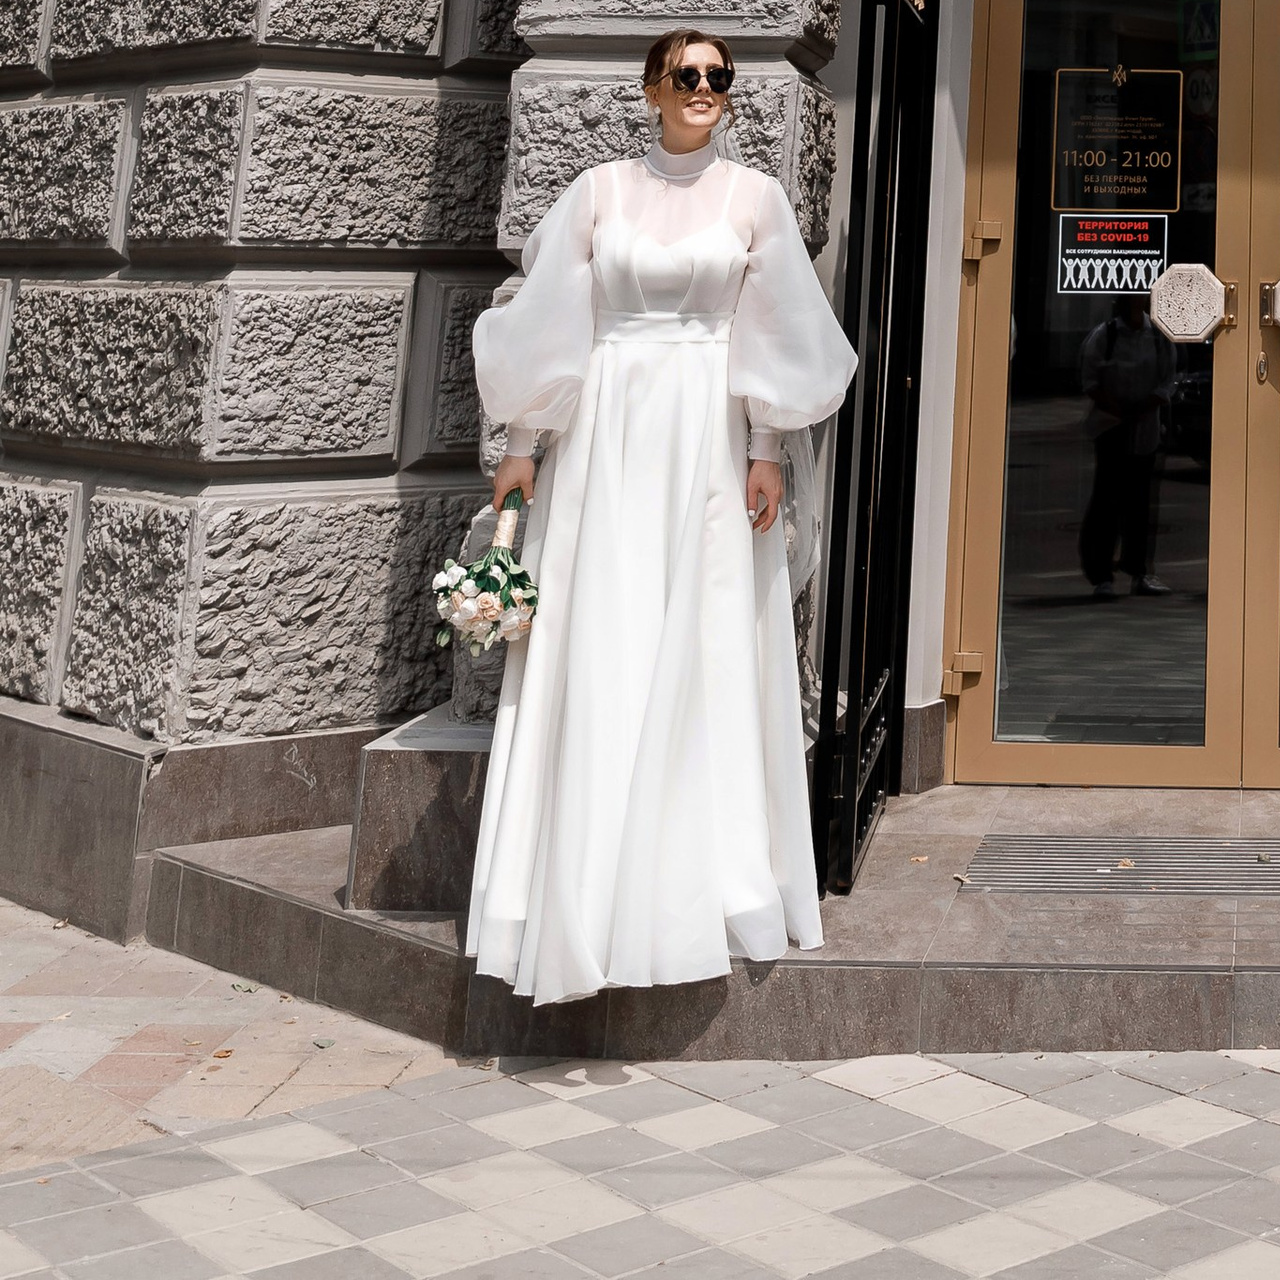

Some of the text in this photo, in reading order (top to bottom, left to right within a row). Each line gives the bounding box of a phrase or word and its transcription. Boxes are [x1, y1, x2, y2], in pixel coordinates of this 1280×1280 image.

[1063, 149, 1107, 167] 11:00
[1121, 150, 1172, 168] 21:00
[1084, 174, 1148, 183] БЕЗ ПЕРЕРЫВА
[1083, 186, 1148, 195] И ВЫХОДНЫХ
[1077, 221, 1149, 230] ТЕРРИТОРИЯ
[1077, 233, 1149, 242] БЕЗ COVID-19
